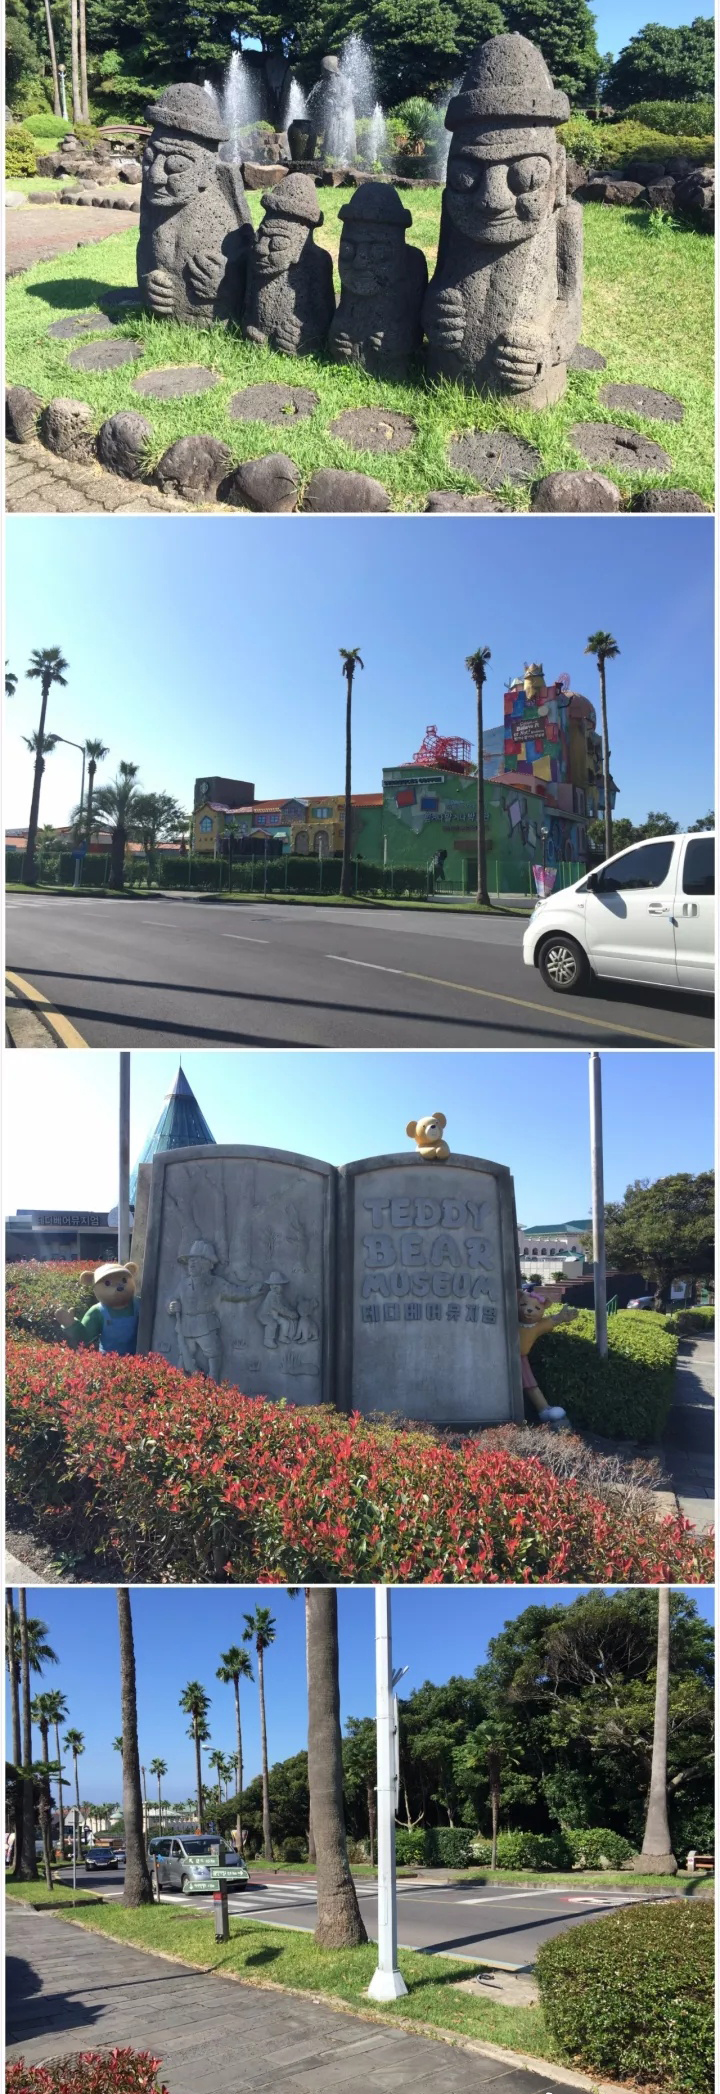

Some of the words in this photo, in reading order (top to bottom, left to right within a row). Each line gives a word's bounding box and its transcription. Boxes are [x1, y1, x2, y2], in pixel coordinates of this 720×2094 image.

[38, 1215, 99, 1226] 테디베어뮤지엄
[363, 1197, 488, 1231] TEDDY
[362, 1232, 496, 1271] BEAR
[361, 1270, 497, 1302] MUSEUM
[361, 1303, 497, 1324] 테디베어뮤지엄
